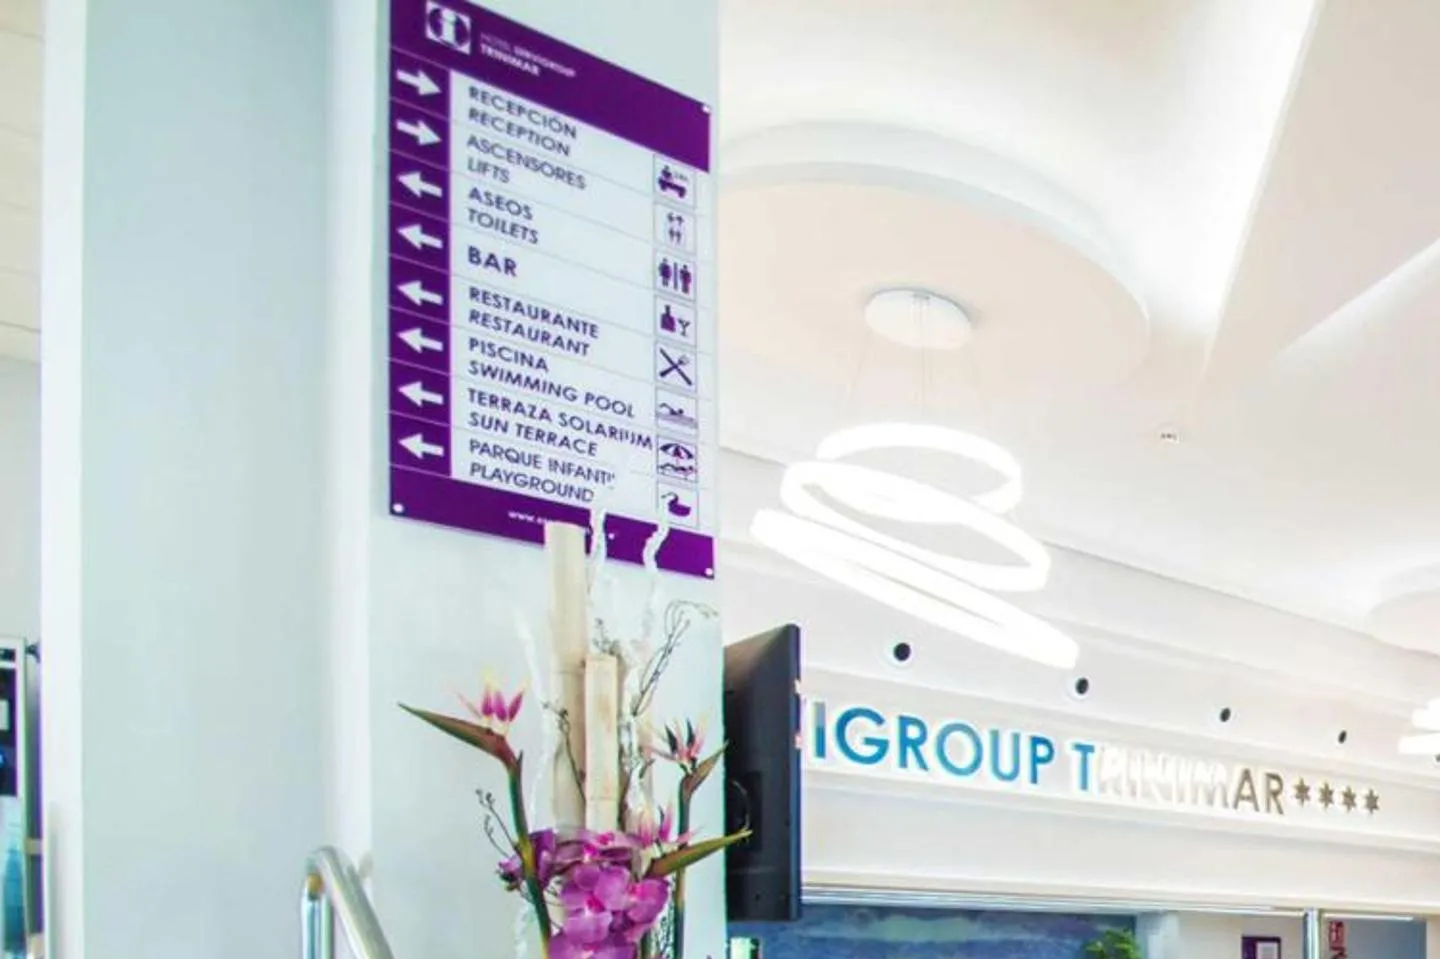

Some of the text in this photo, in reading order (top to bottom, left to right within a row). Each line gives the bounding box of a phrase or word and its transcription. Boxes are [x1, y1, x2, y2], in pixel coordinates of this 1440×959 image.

[468, 108, 570, 157] RECEPTION
[467, 135, 586, 190] ASCENSORES
[467, 157, 510, 184] LIFTS
[468, 187, 533, 221] ASEOS
[467, 208, 539, 245] TOILETS
[468, 246, 517, 277] BAR
[469, 287, 599, 339] RESTAURANTE
[469, 309, 590, 356] RESTAURANT
[469, 337, 549, 373] PISCINA
[467, 388, 551, 422] TERRAZA
[468, 360, 635, 418] SWIMMING POOL
[469, 412, 598, 457] SUN TERRACE
[470, 439, 541, 469] PARQUE
[470, 462, 594, 503] PLAYGROUND
